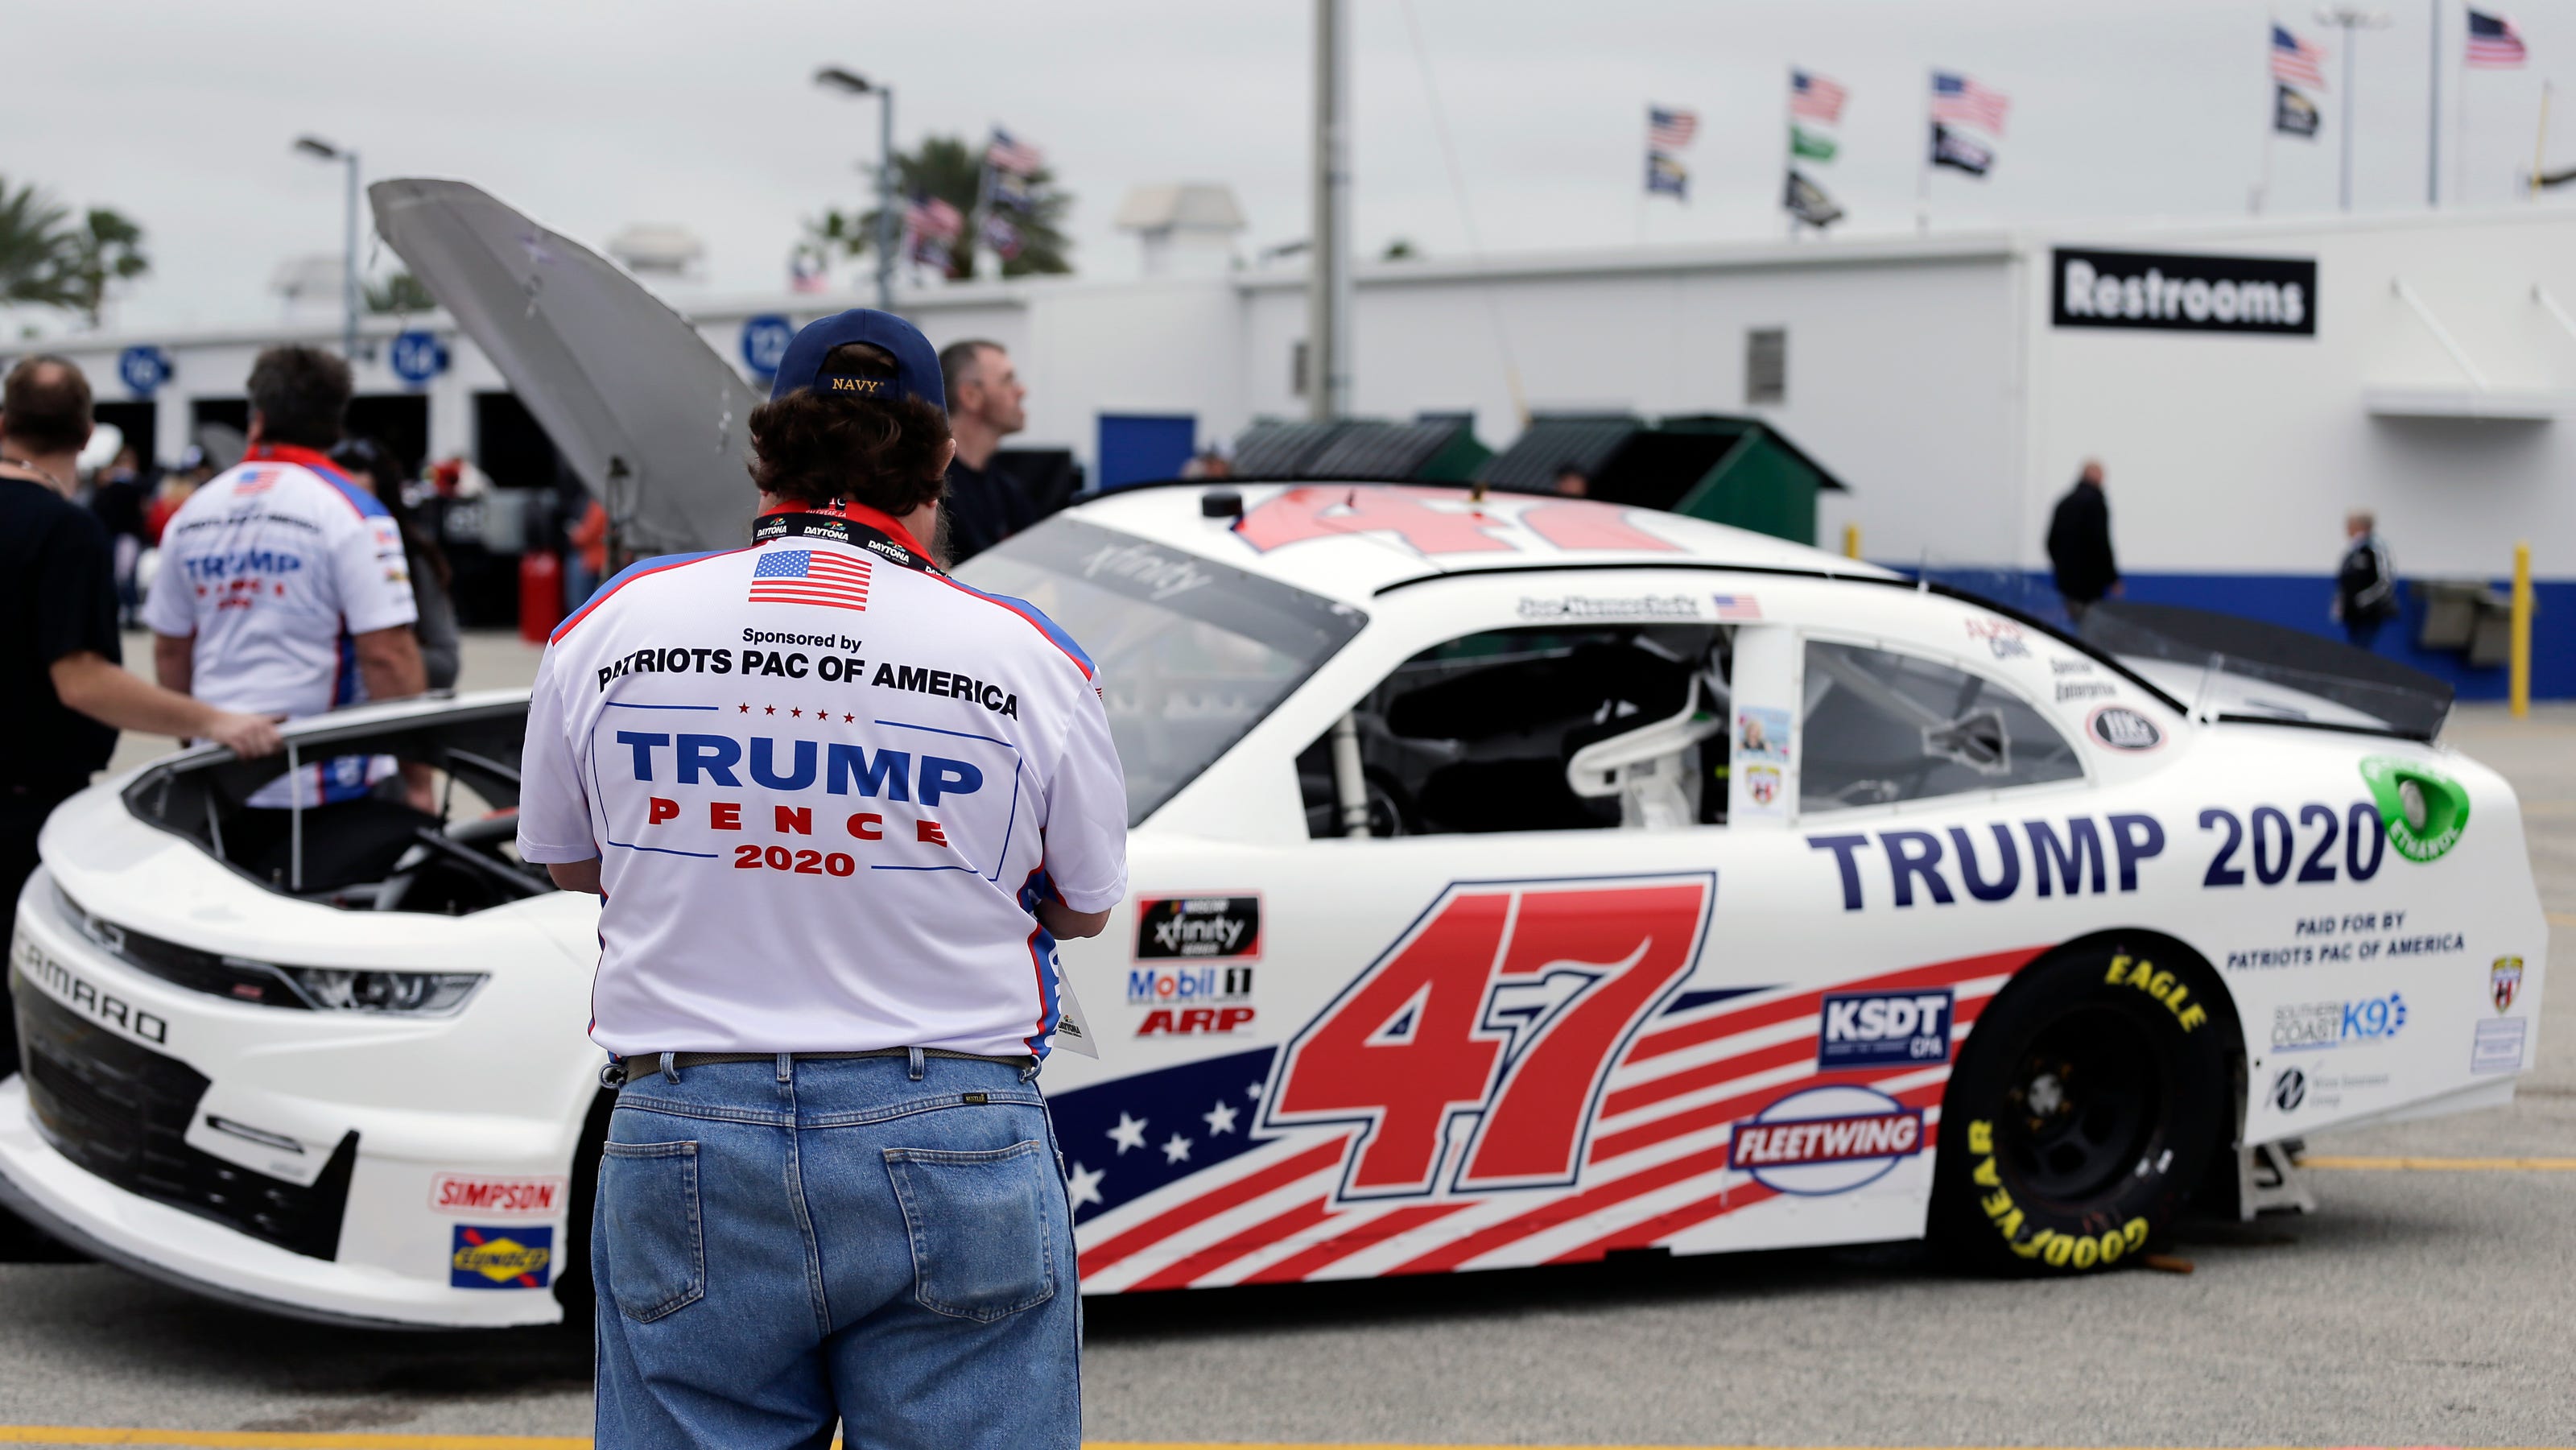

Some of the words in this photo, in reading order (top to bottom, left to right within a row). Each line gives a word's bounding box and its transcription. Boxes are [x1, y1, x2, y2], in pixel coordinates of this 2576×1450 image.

[2063, 258, 2305, 326] Restrooms
[757, 525, 787, 537] DAYTONA
[803, 526, 849, 541] DAYTONA
[184, 547, 302, 578] TRUMP
[868, 539, 910, 563] DAYTONA
[742, 627, 836, 648] Sponsored
[840, 634, 862, 654] by
[597, 647, 733, 693] PATRIOTS
[741, 650, 809, 679] PAC
[817, 655, 865, 684] OF
[871, 662, 1018, 721] AMERICA
[617, 729, 984, 808] TRUMP
[648, 796, 948, 848] PENCE
[2388, 817, 2461, 861] ETHANOL
[734, 844, 856, 877] 2020
[1806, 812, 2166, 911] TRUMP
[2198, 801, 2387, 888] 2020
[1154, 912, 1245, 952] xfinity
[2295, 915, 2337, 936] PAID
[2341, 912, 2377, 932] FOR
[2382, 909, 2406, 928] BY
[2226, 946, 2314, 971] PATRIOTS
[2318, 943, 2353, 963] PAC
[2358, 940, 2382, 960] OF
[2386, 932, 2465, 956] AMERICA
[1129, 968, 1216, 999] Mobil
[2103, 953, 2209, 1034] EAGLE
[1136, 1007, 1256, 1037] ARP
[1261, 869, 1717, 1204] 47
[1824, 994, 1949, 1043] KSDT
[2270, 1018, 2340, 1045] COAST
[2341, 998, 2388, 1039] K9
[1909, 1035, 1945, 1060] CPA
[1734, 1115, 1920, 1166] FLEETWING
[439, 1180, 556, 1210] SIMPSON
[1967, 1118, 2150, 1270] GOODYEAR
[456, 1250, 547, 1270] SUNOCO
